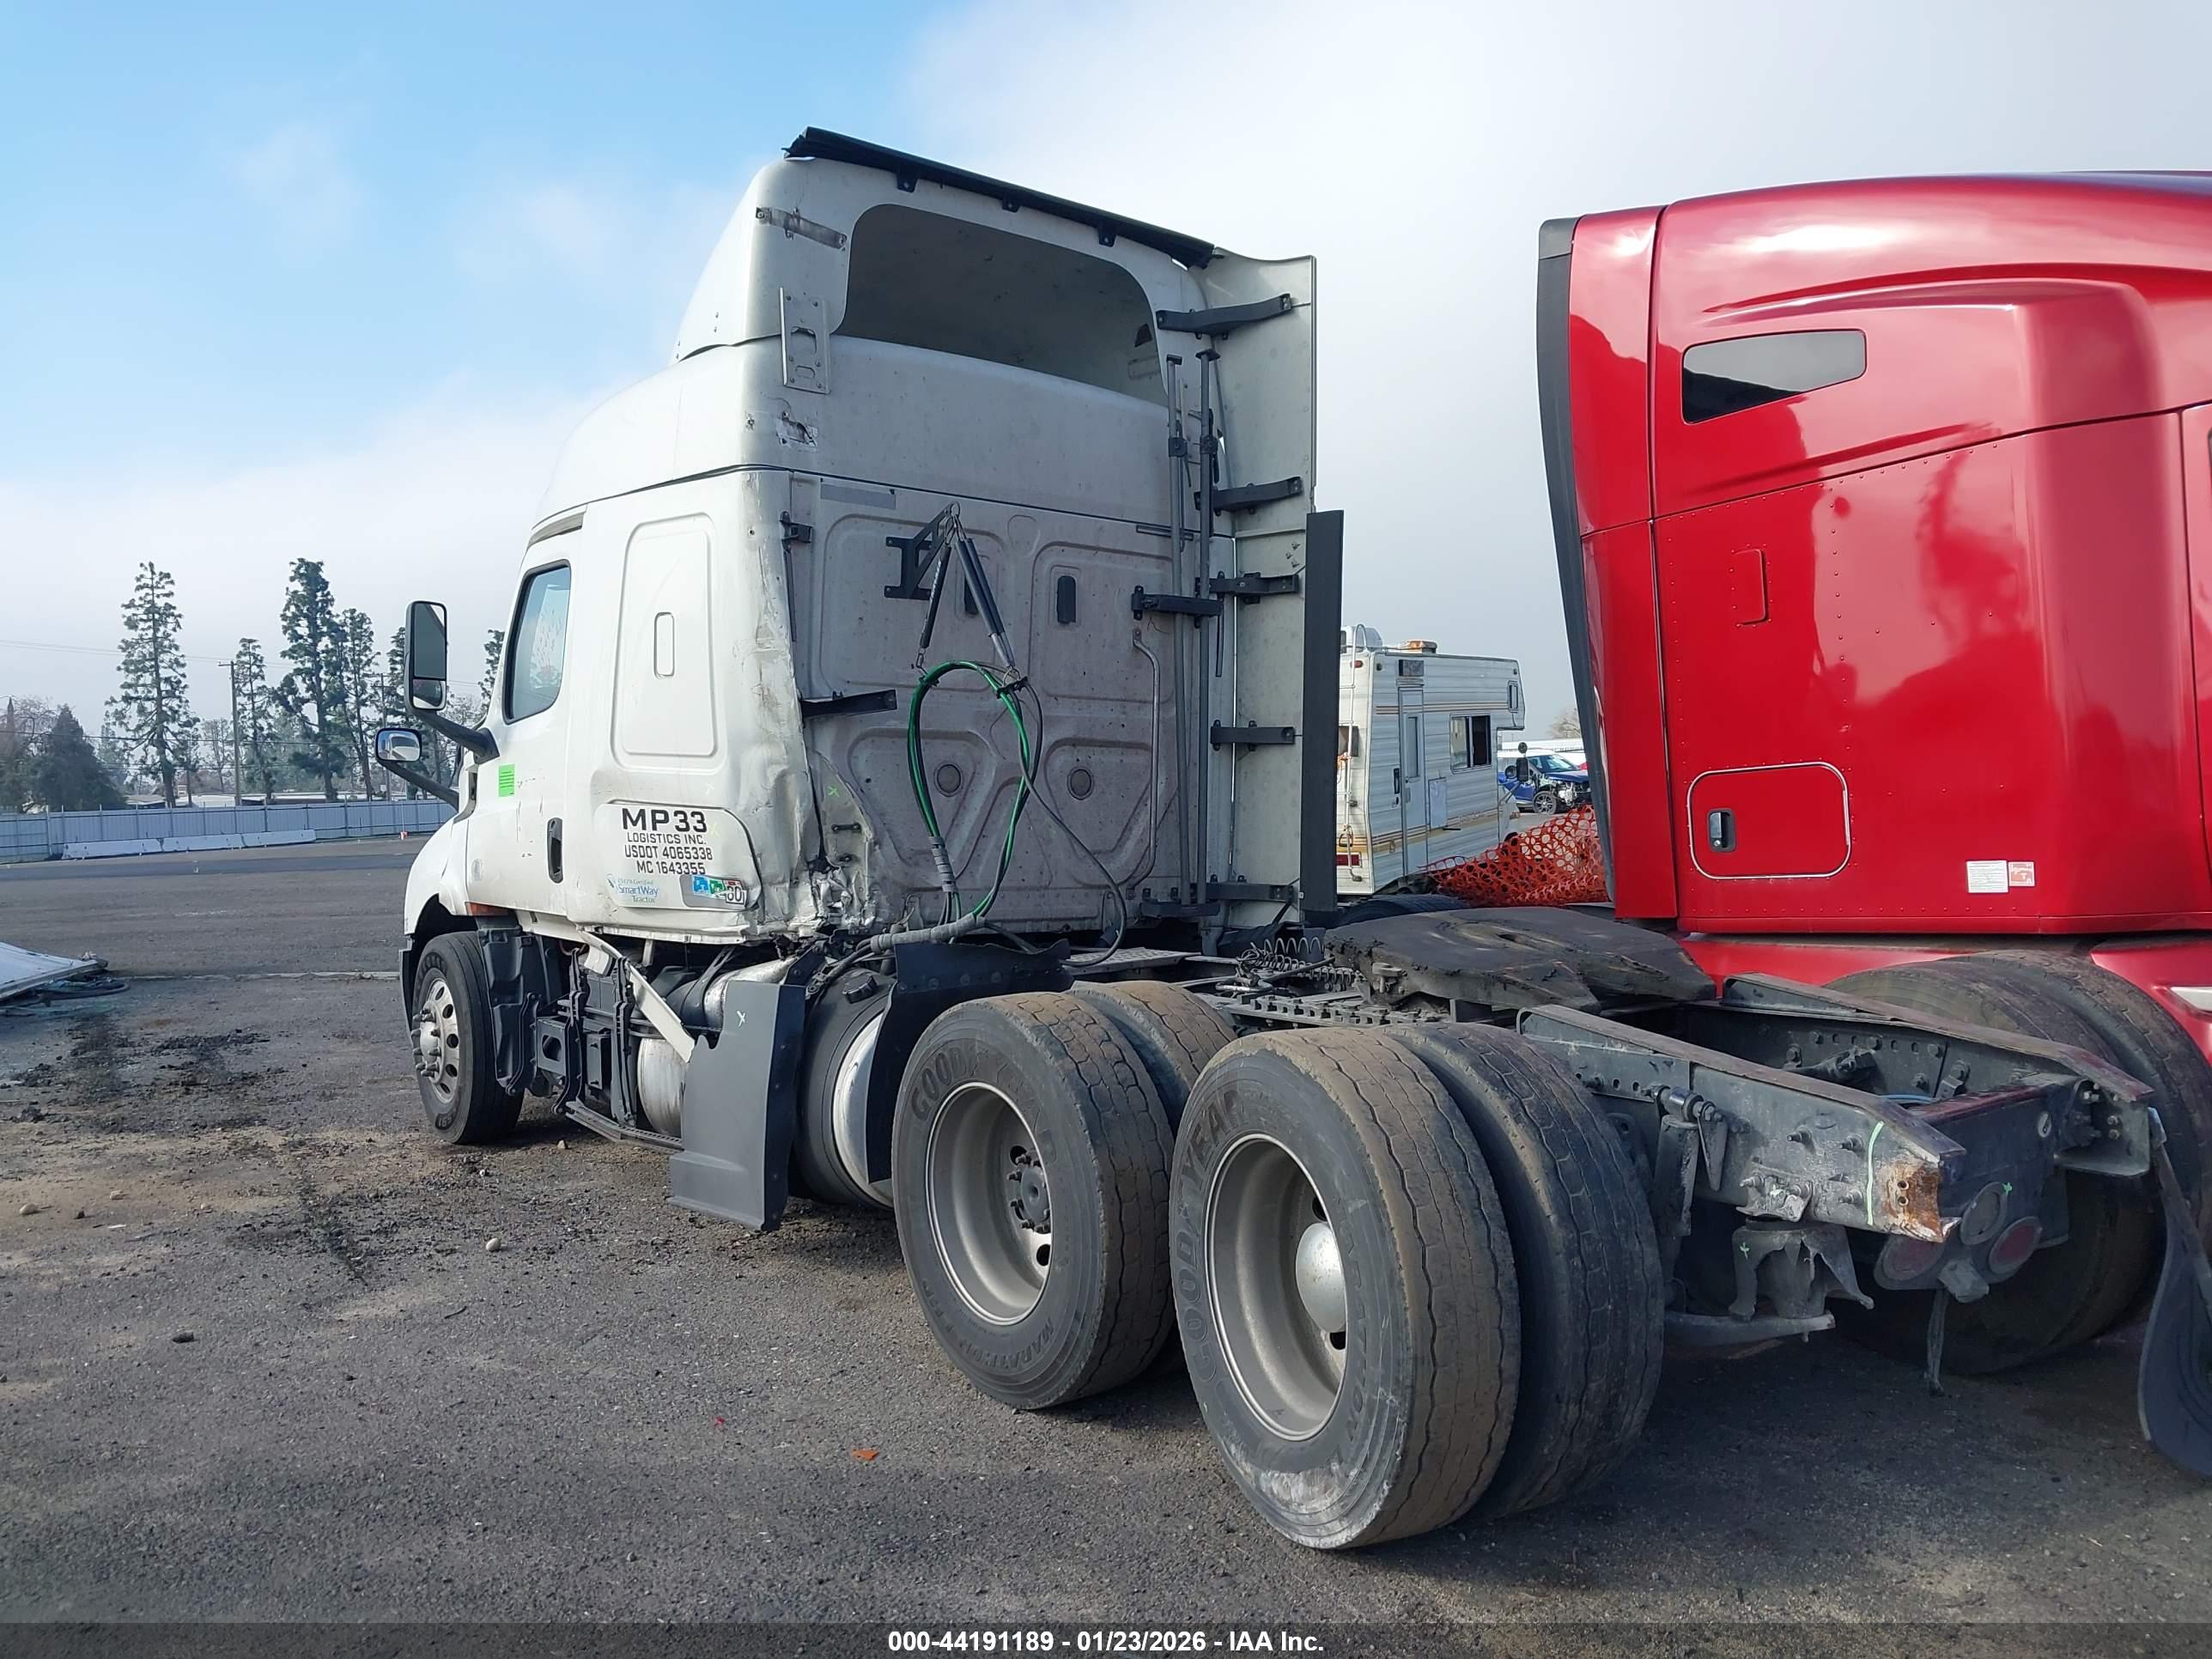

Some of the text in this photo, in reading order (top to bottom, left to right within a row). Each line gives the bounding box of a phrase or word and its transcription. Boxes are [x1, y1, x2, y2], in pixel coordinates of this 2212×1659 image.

[622, 808, 708, 833] MP33
[627, 832, 707, 845] LOGISTICS INC.
[624, 845, 713, 860] USDOT 4065338
[636, 860, 706, 875] MC 1643355
[618, 884, 659, 897] SmartWay
